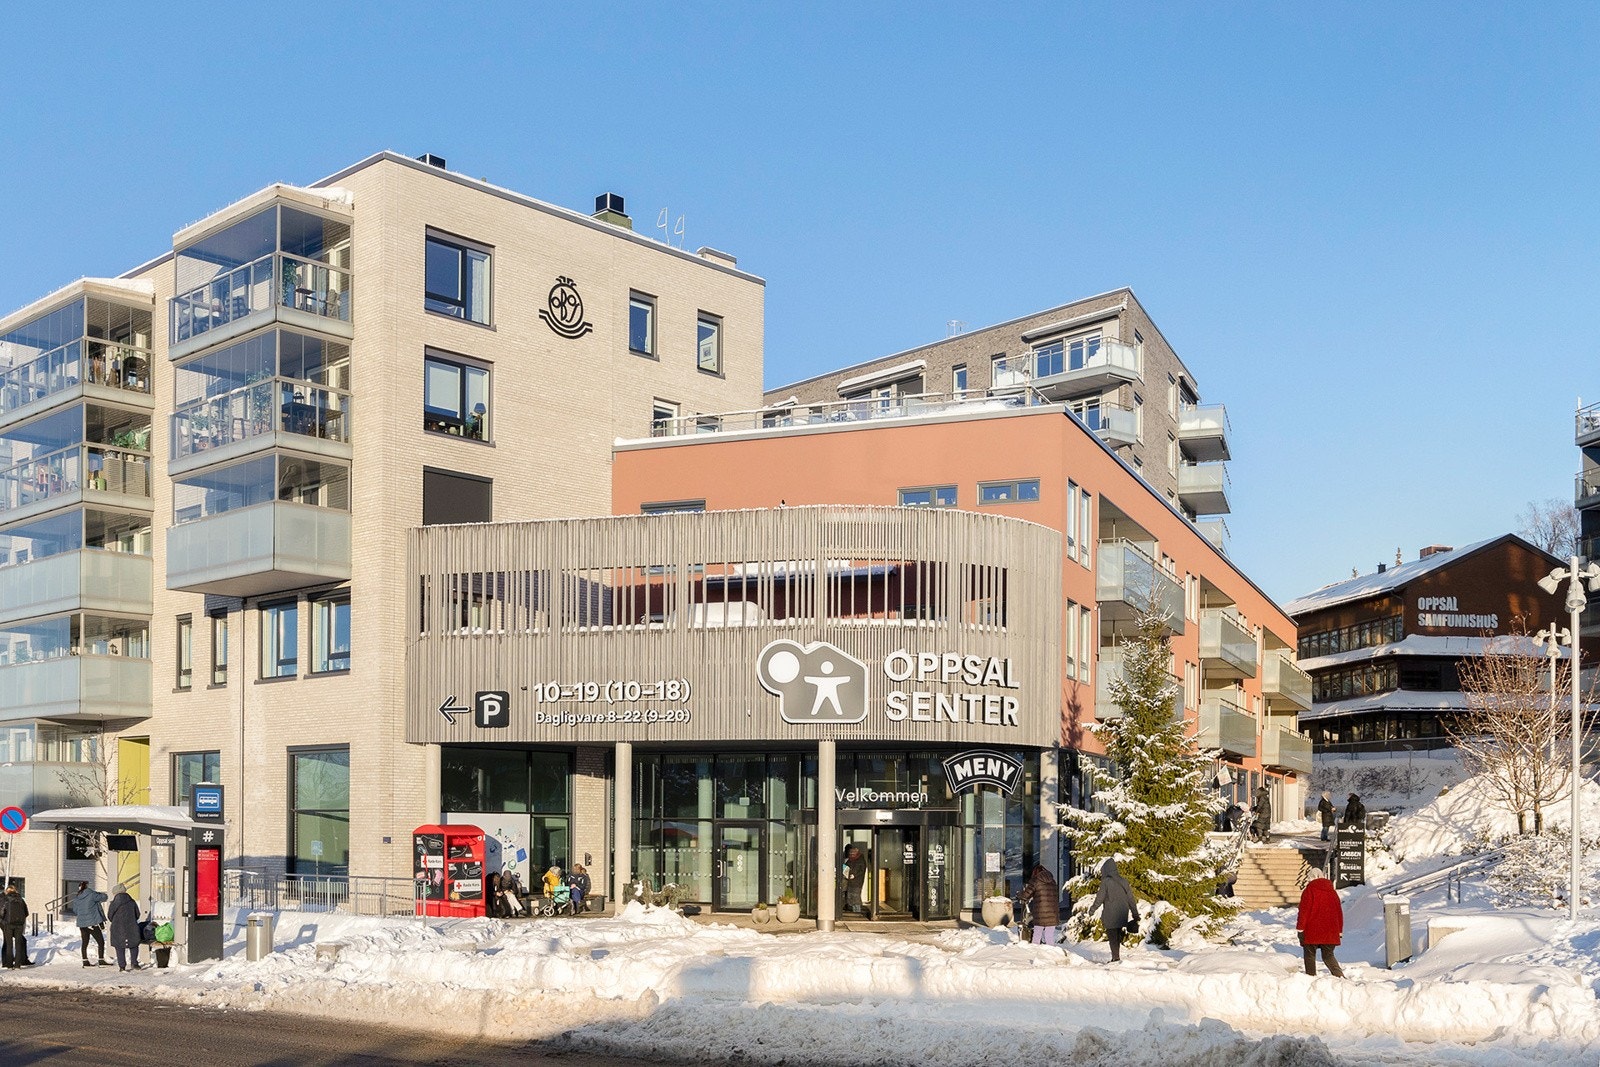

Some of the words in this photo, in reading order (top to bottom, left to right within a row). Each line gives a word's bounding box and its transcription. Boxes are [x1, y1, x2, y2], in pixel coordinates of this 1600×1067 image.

[1417, 596, 1459, 612] OPPSAL
[1417, 613, 1499, 629] SAMFUNNSHUS
[883, 648, 1020, 690] OPPSAL
[533, 680, 601, 703] 10-19
[885, 690, 1020, 727] SENTER
[535, 711, 605, 727] Dagligvare
[953, 757, 1016, 782] MENY
[835, 787, 929, 803] Velkommen
